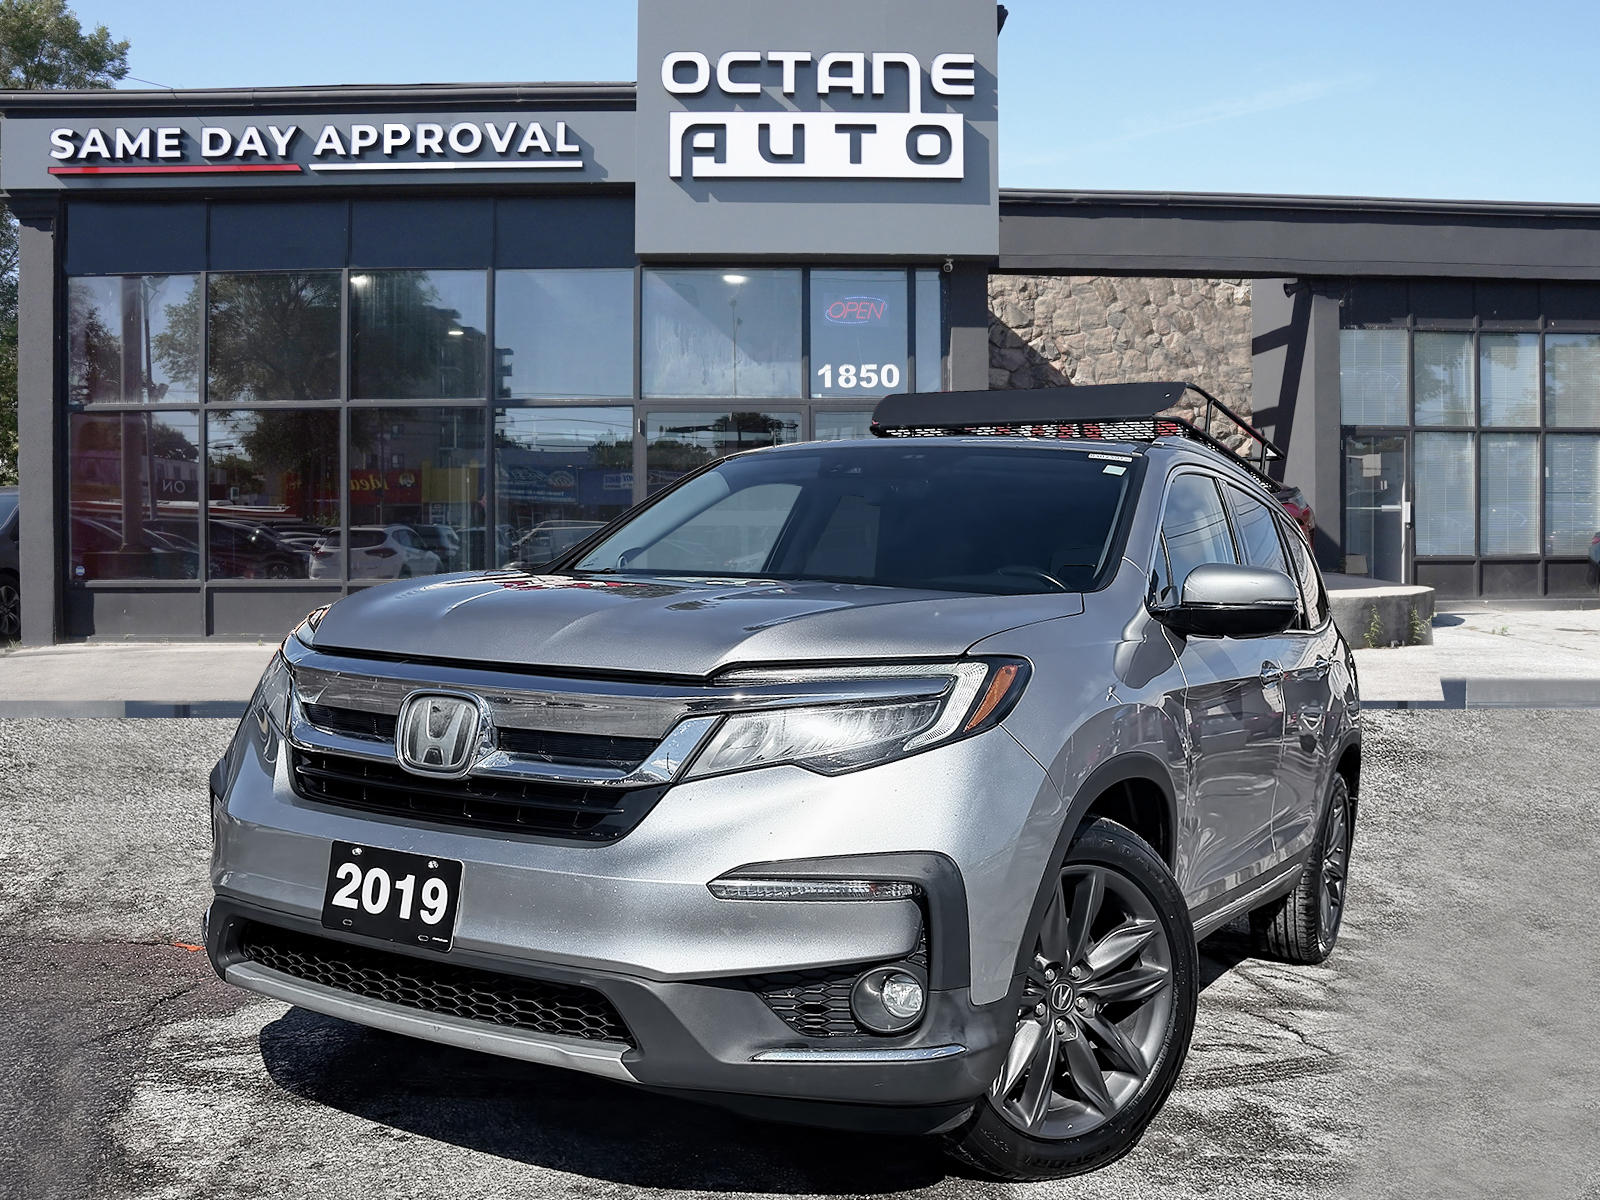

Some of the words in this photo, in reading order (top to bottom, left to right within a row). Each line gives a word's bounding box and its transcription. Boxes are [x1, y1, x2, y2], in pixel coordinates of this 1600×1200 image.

[661, 51, 975, 96] OCTANE
[49, 126, 182, 160] SAME
[200, 125, 299, 158] DAY
[313, 121, 580, 157] APPROVAL
[679, 121, 954, 178] AUTO
[828, 301, 886, 320] OPEN
[817, 363, 900, 388] 1850
[331, 862, 449, 925] 2019
